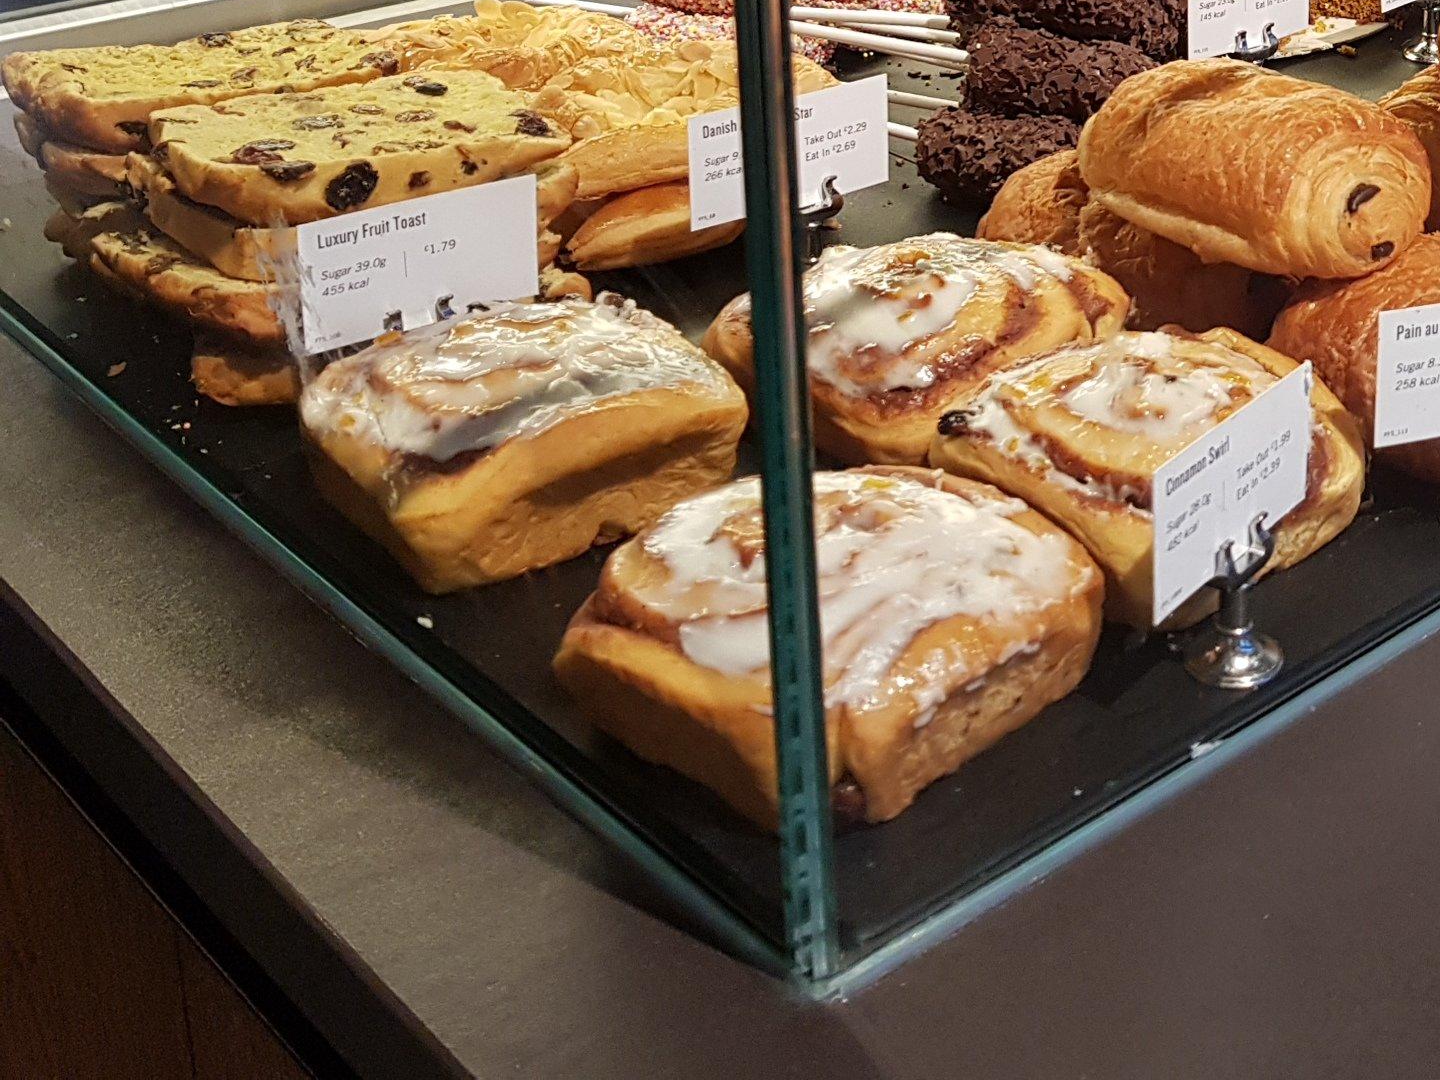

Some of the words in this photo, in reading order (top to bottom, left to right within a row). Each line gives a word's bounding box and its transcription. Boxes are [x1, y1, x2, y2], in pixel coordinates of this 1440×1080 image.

[1199, 0, 1216, 11] Sugar
[1255, 1, 1266, 10] Eat
[1200, 13, 1212, 22] 145
[1213, 9, 1226, 18] kcal
[702, 120, 737, 139] Danish
[794, 106, 814, 121] Star
[804, 134, 825, 146] Take
[826, 129, 842, 140] Out
[704, 155, 730, 168] Sugar
[805, 150, 820, 162] Eat
[822, 147, 831, 157] In
[704, 170, 723, 182] 266
[725, 166, 744, 177] kca
[317, 229, 358, 249] Luxury
[362, 221, 390, 240] Fruit
[393, 212, 426, 230] Toast
[321, 266, 352, 282] Sugar
[355, 257, 387, 272] 39.0g
[321, 285, 346, 297] 455
[348, 277, 370, 291] kcal
[1396, 324, 1422, 340] Pain
[1425, 324, 1439, 336] au
[1396, 360, 1425, 374] Sugar
[1395, 379, 1417, 391] 258
[1419, 375, 1440, 386] kcal
[1166, 456, 1207, 496] Cinnamon
[1208, 435, 1230, 465] Swirl
[1236, 460, 1254, 479] Take
[1256, 447, 1269, 466] Out
[1236, 483, 1249, 500] Eat
[1166, 510, 1188, 534] Sugar
[1184, 519, 1200, 538] kcal
